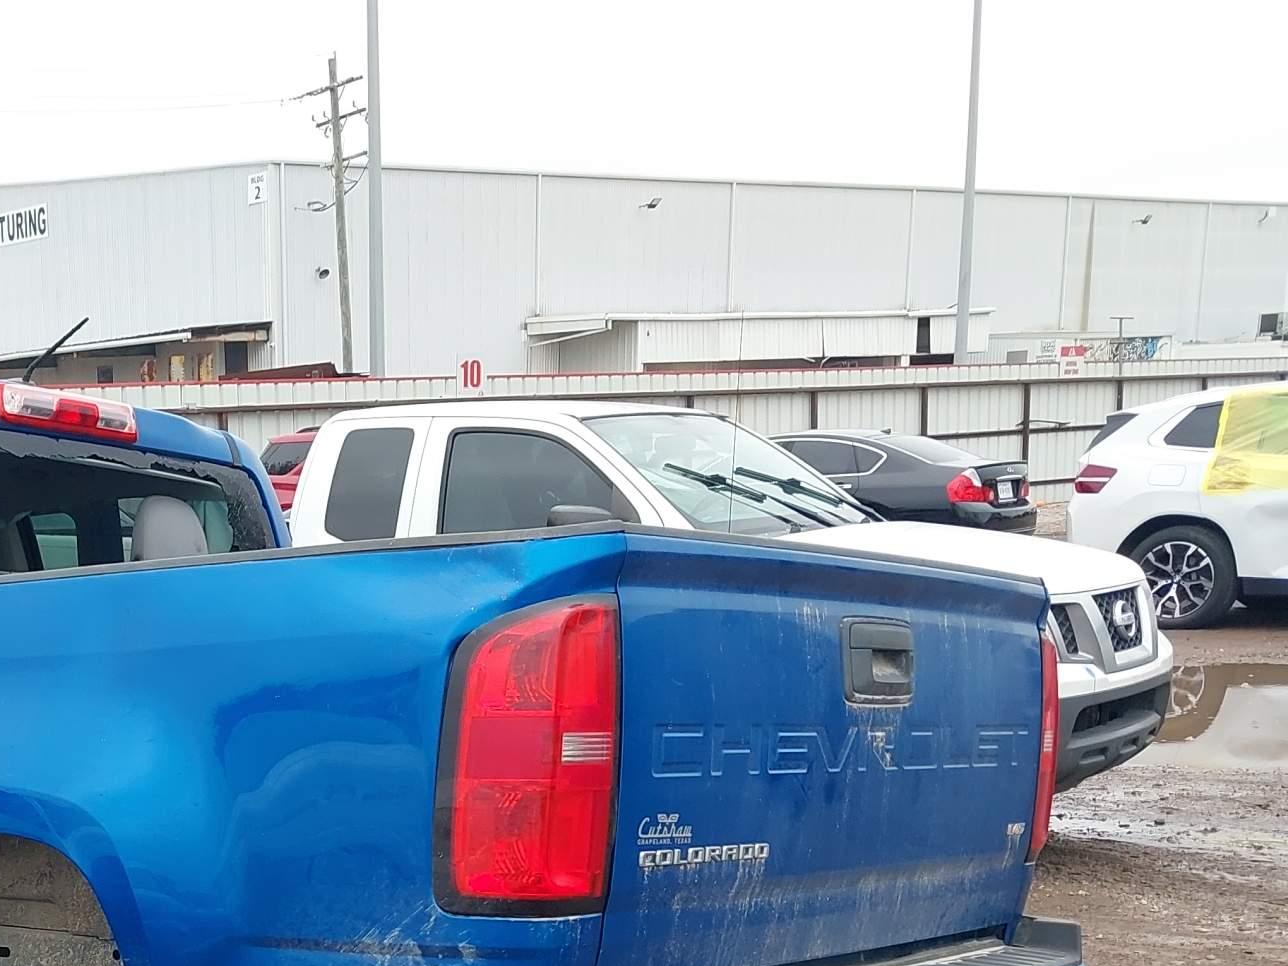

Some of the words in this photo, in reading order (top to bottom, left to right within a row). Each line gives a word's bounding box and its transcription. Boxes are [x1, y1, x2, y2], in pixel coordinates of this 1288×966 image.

[254, 186, 261, 200] 2
[460, 360, 481, 387] 10
[652, 723, 1029, 777] CHEVROLET
[639, 843, 770, 867] COLORADO
